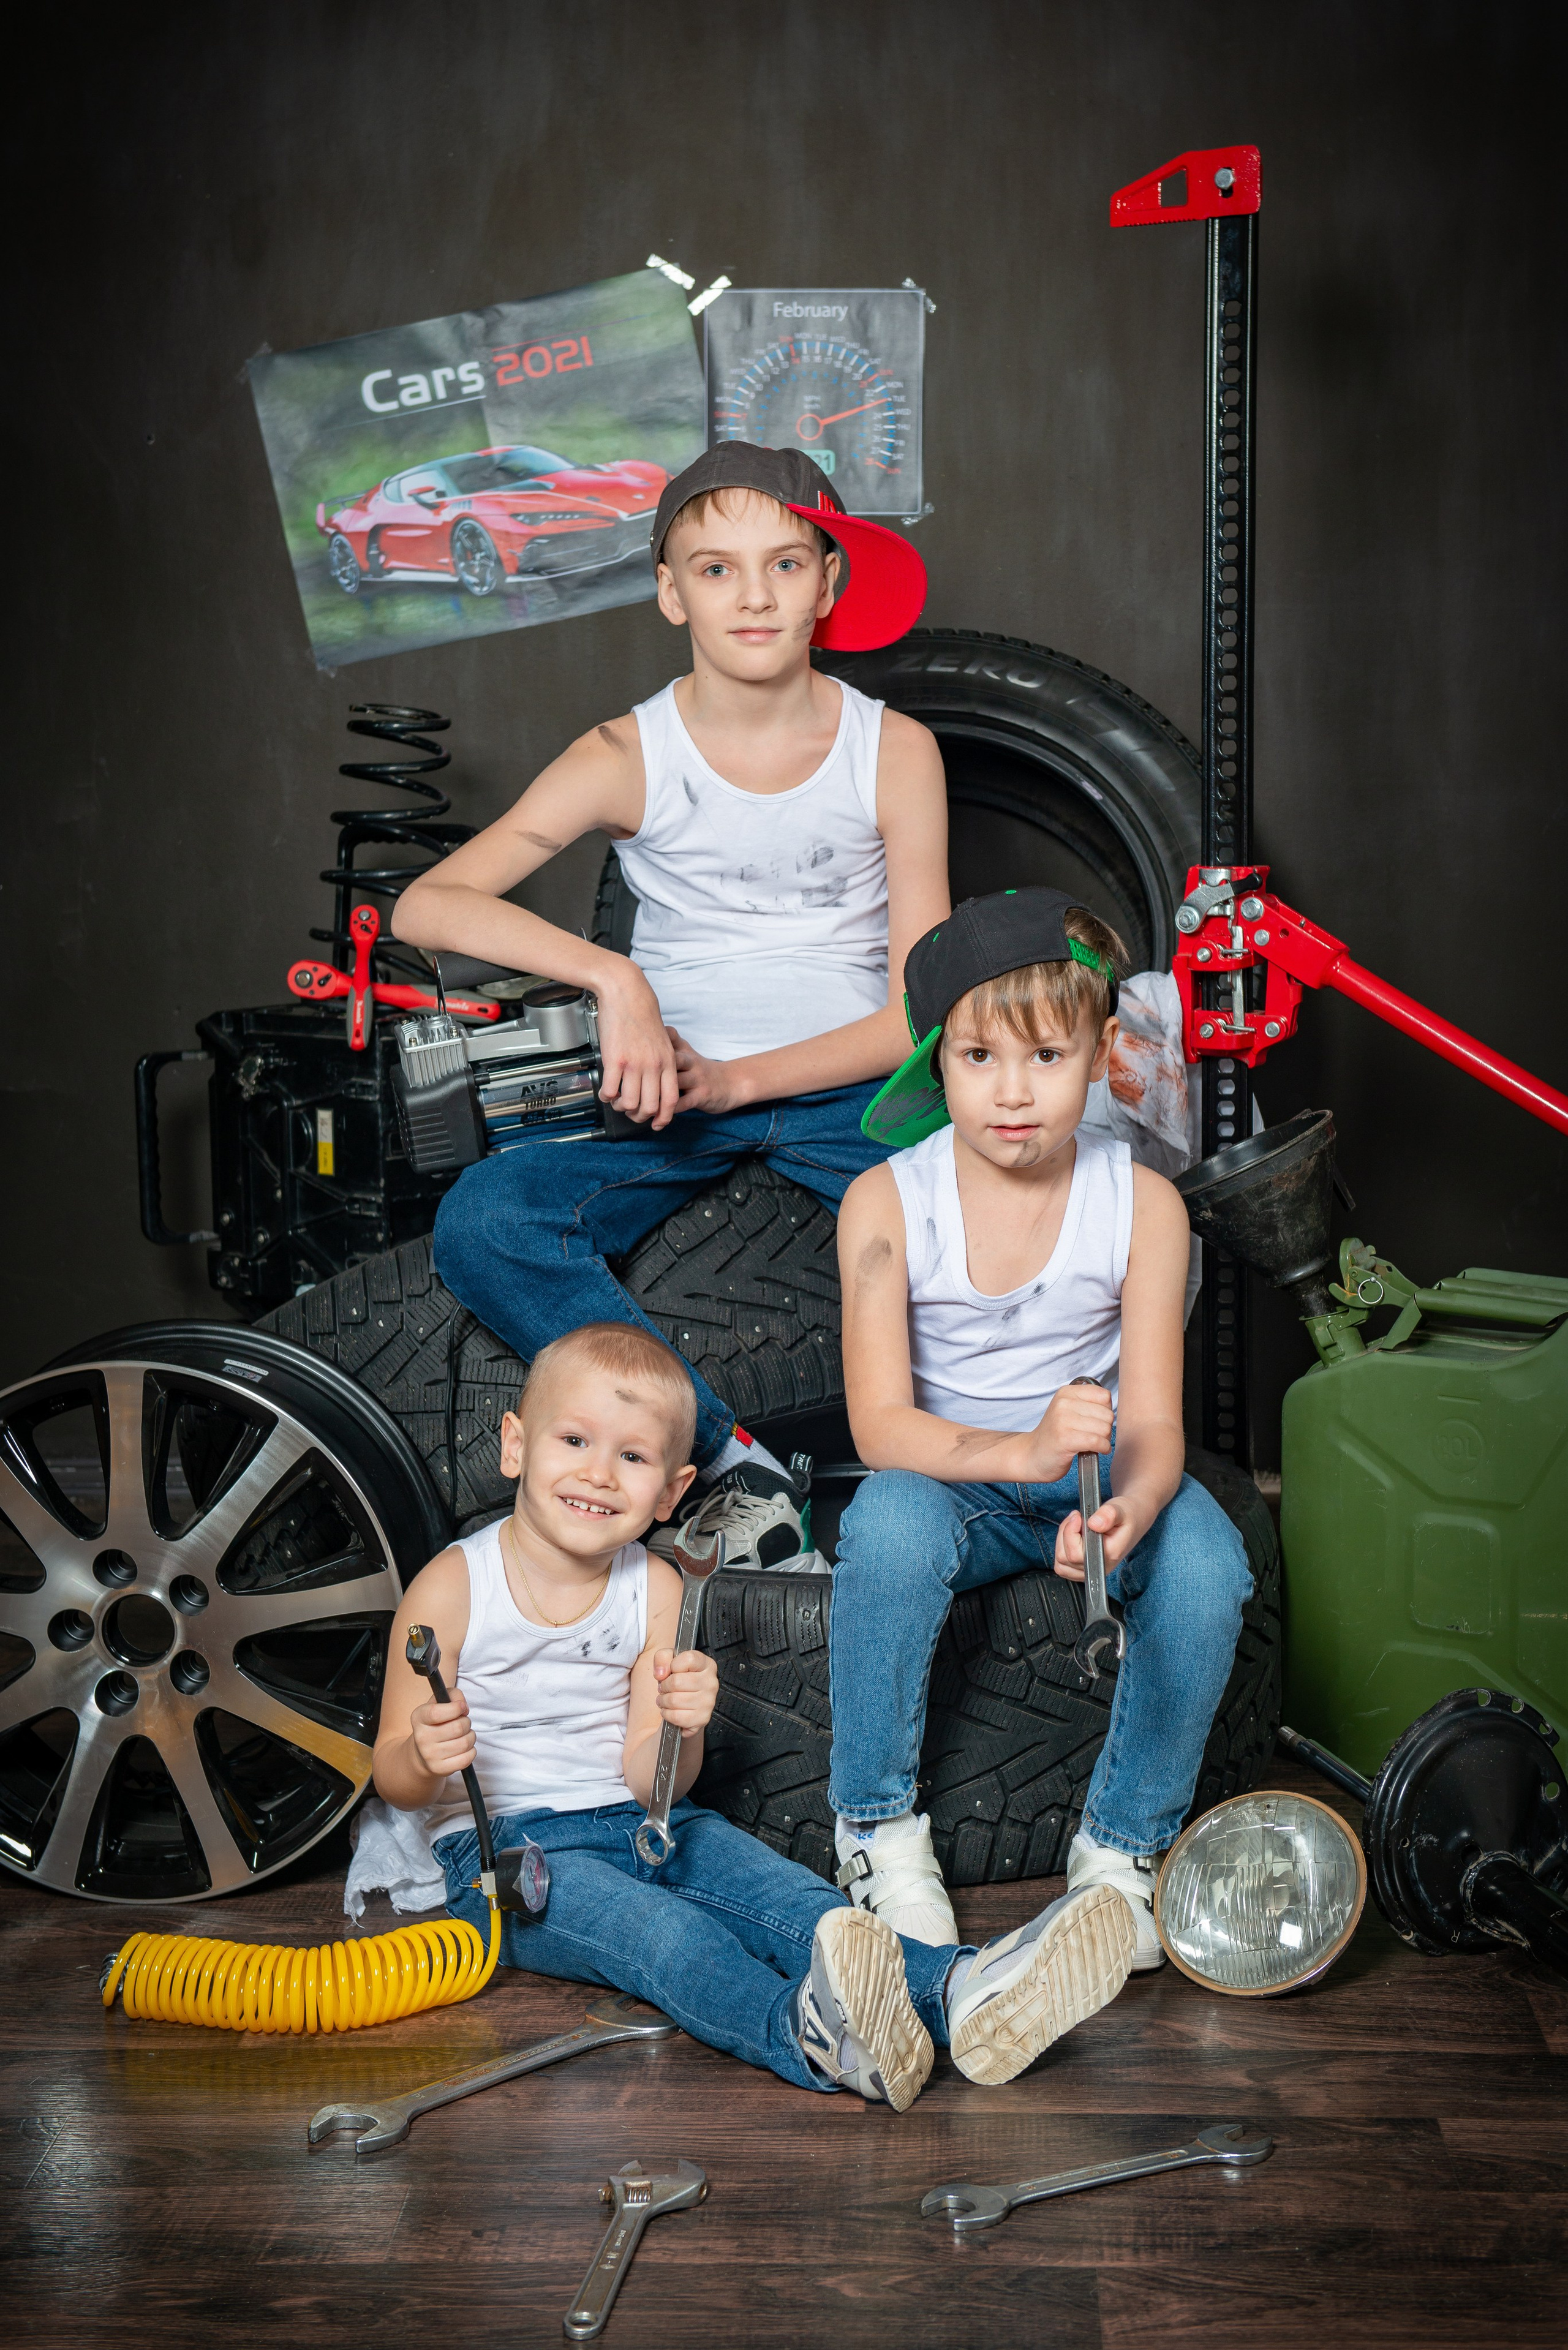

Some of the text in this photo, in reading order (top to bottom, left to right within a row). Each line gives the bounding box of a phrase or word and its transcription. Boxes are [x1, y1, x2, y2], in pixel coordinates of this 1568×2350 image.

[773, 302, 848, 321] February
[362, 336, 594, 413] Cars 2021
[889, 652, 1046, 689] ZERO
[524, 1096, 556, 1110] TURBO
